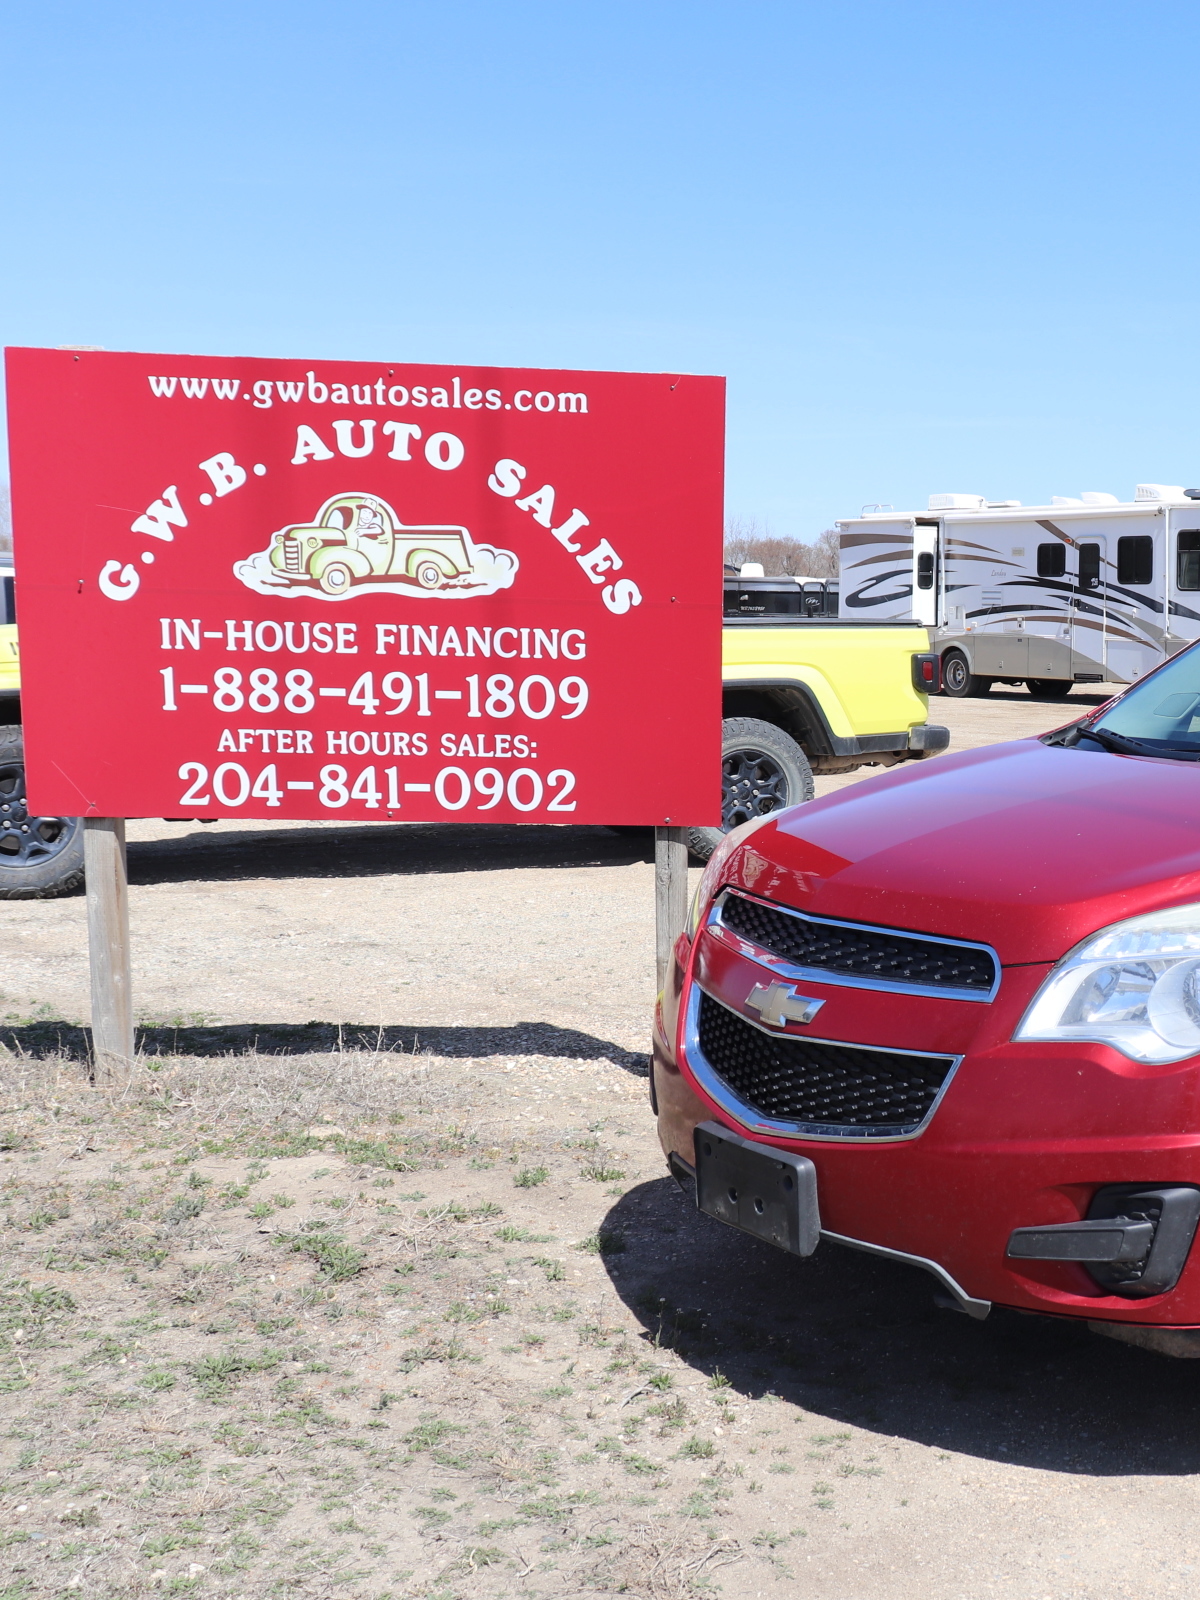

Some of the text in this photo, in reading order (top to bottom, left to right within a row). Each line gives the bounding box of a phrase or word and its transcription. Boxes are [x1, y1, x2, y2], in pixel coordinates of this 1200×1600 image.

[147, 371, 589, 413] www.gwbautosales.com
[98, 419, 643, 615] G.W.B. AUTO SALES
[159, 617, 587, 661] IN-HOUSE FINANCING
[159, 666, 589, 720] 1-888-491-1809
[216, 728, 538, 760] AFTER HOURS SALES:
[177, 761, 577, 812] 204-841-0902
